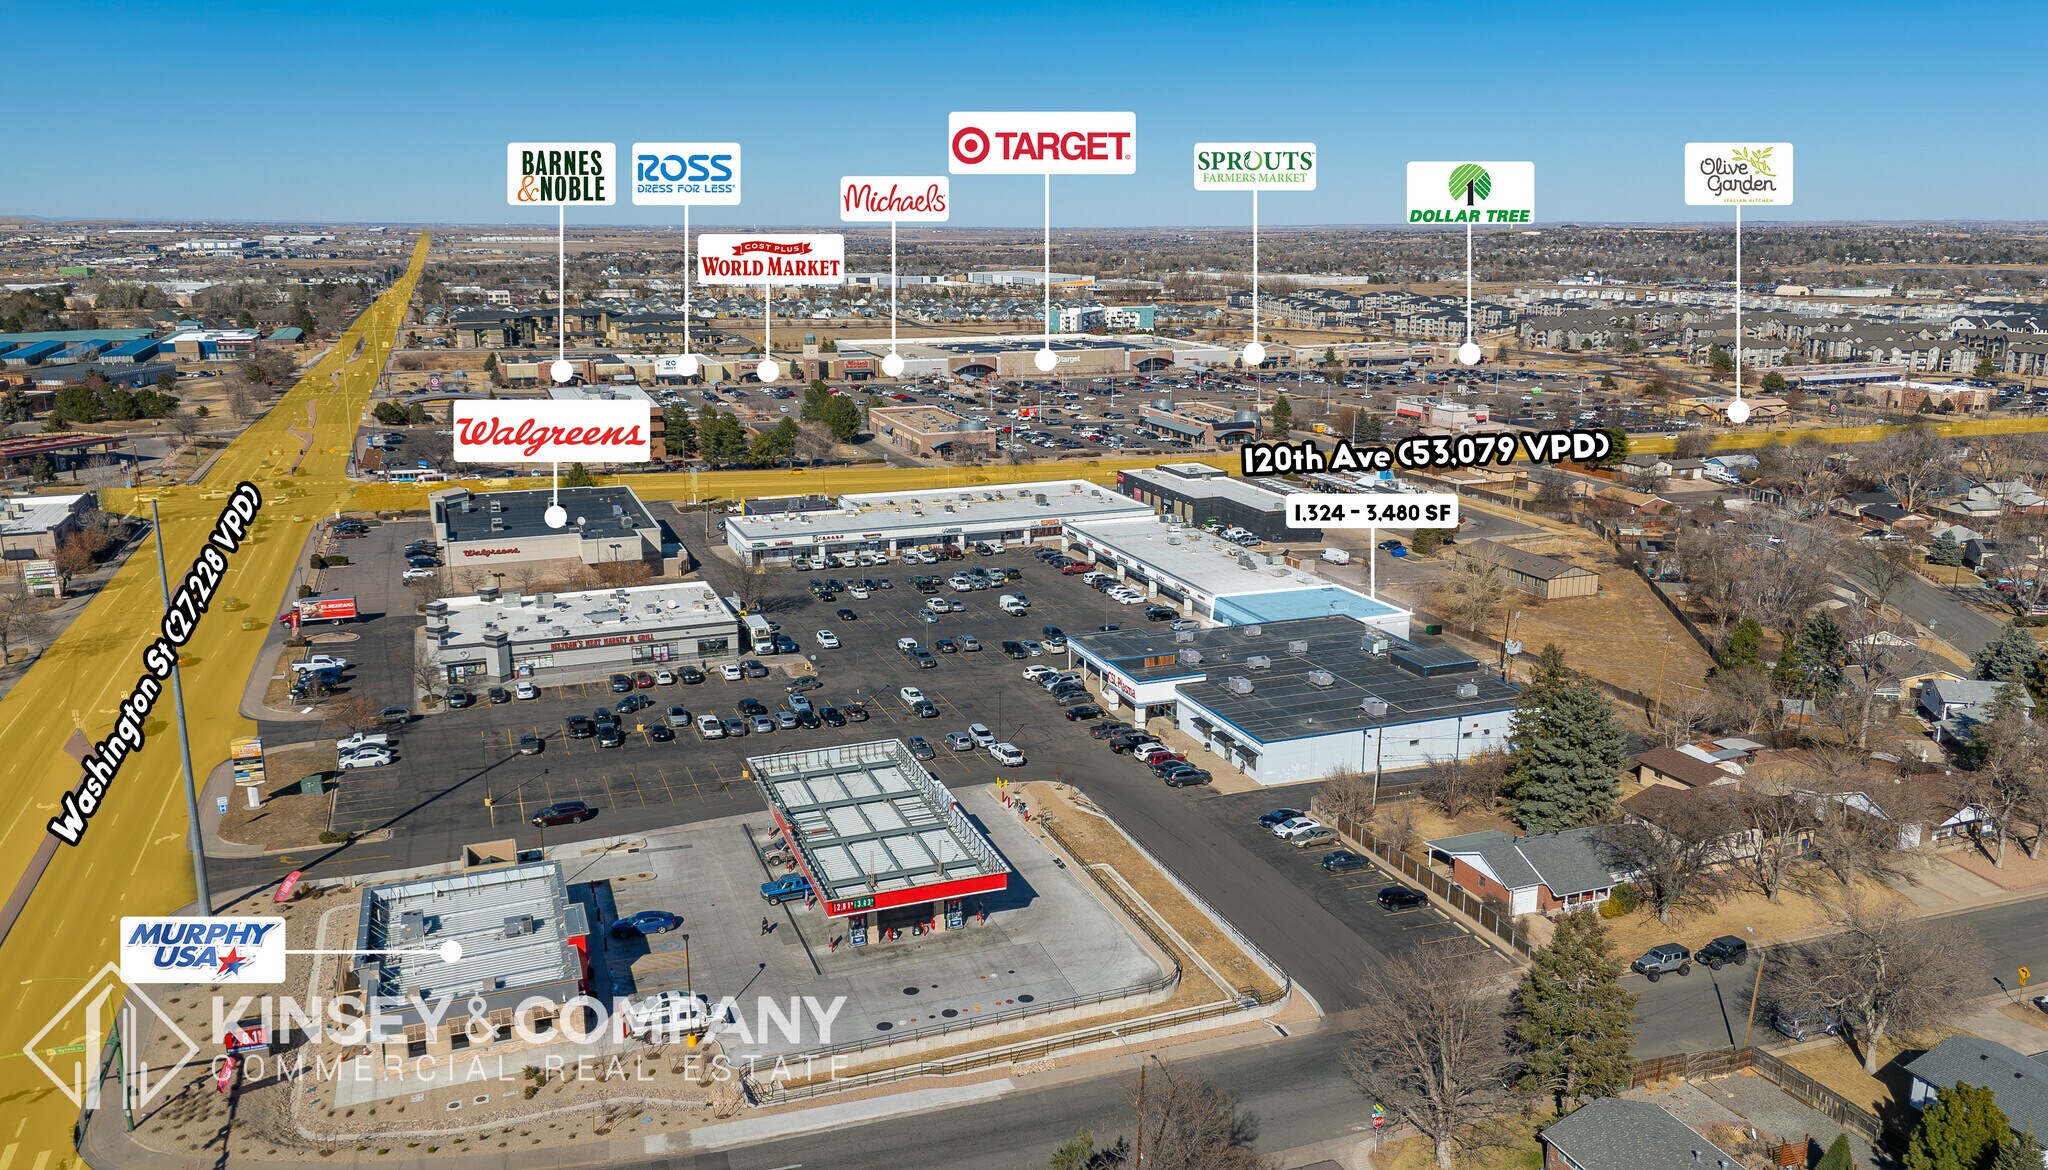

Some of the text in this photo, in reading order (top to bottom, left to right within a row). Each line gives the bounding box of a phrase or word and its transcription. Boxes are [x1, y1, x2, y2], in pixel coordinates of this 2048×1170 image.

[463, 548, 521, 558] Walgreens
[603, 636, 628, 646] MARKET
[628, 635, 636, 643] &
[637, 633, 655, 642] GRILL
